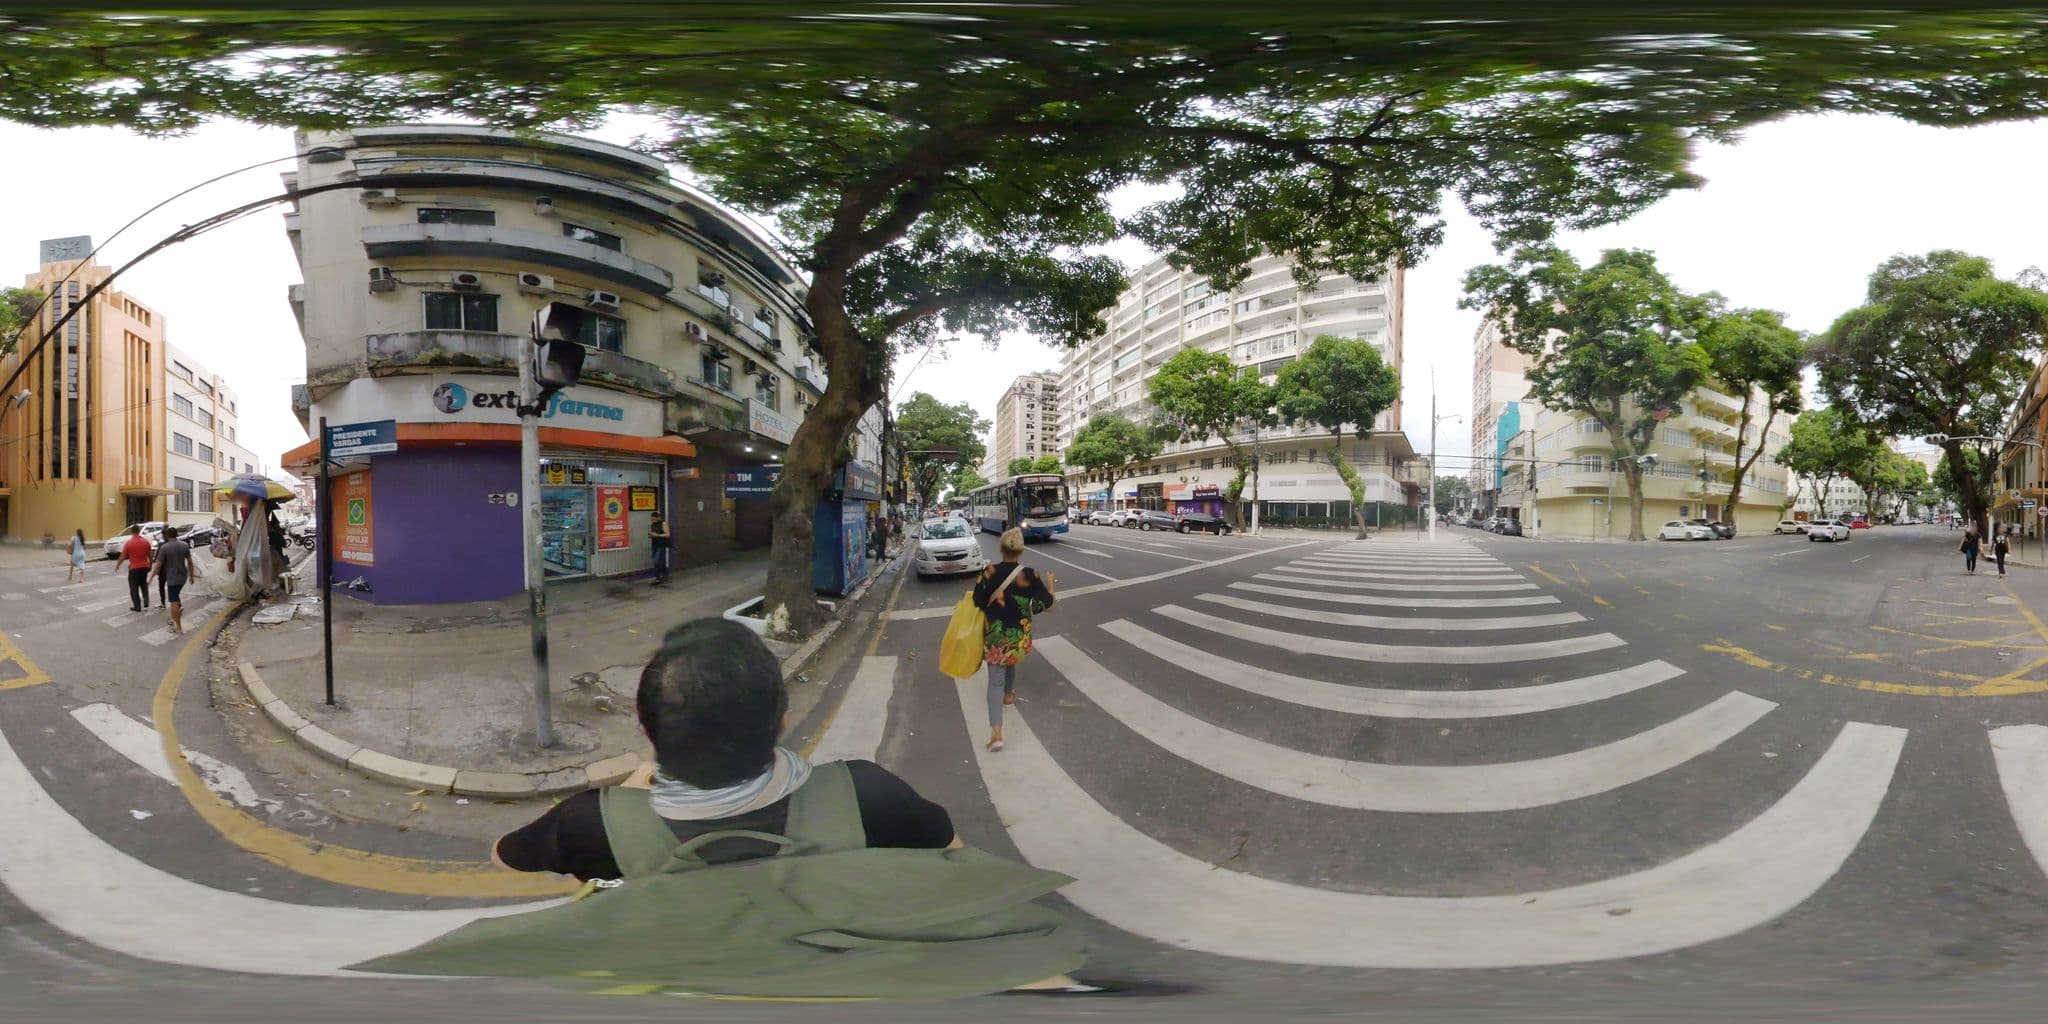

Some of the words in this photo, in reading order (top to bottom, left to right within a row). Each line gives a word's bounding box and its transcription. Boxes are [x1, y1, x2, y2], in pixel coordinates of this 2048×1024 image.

[472, 390, 625, 421] extfarma
[333, 429, 377, 440] PRESIDENTE
[333, 438, 362, 448] VARGAS
[736, 473, 752, 482] TIM
